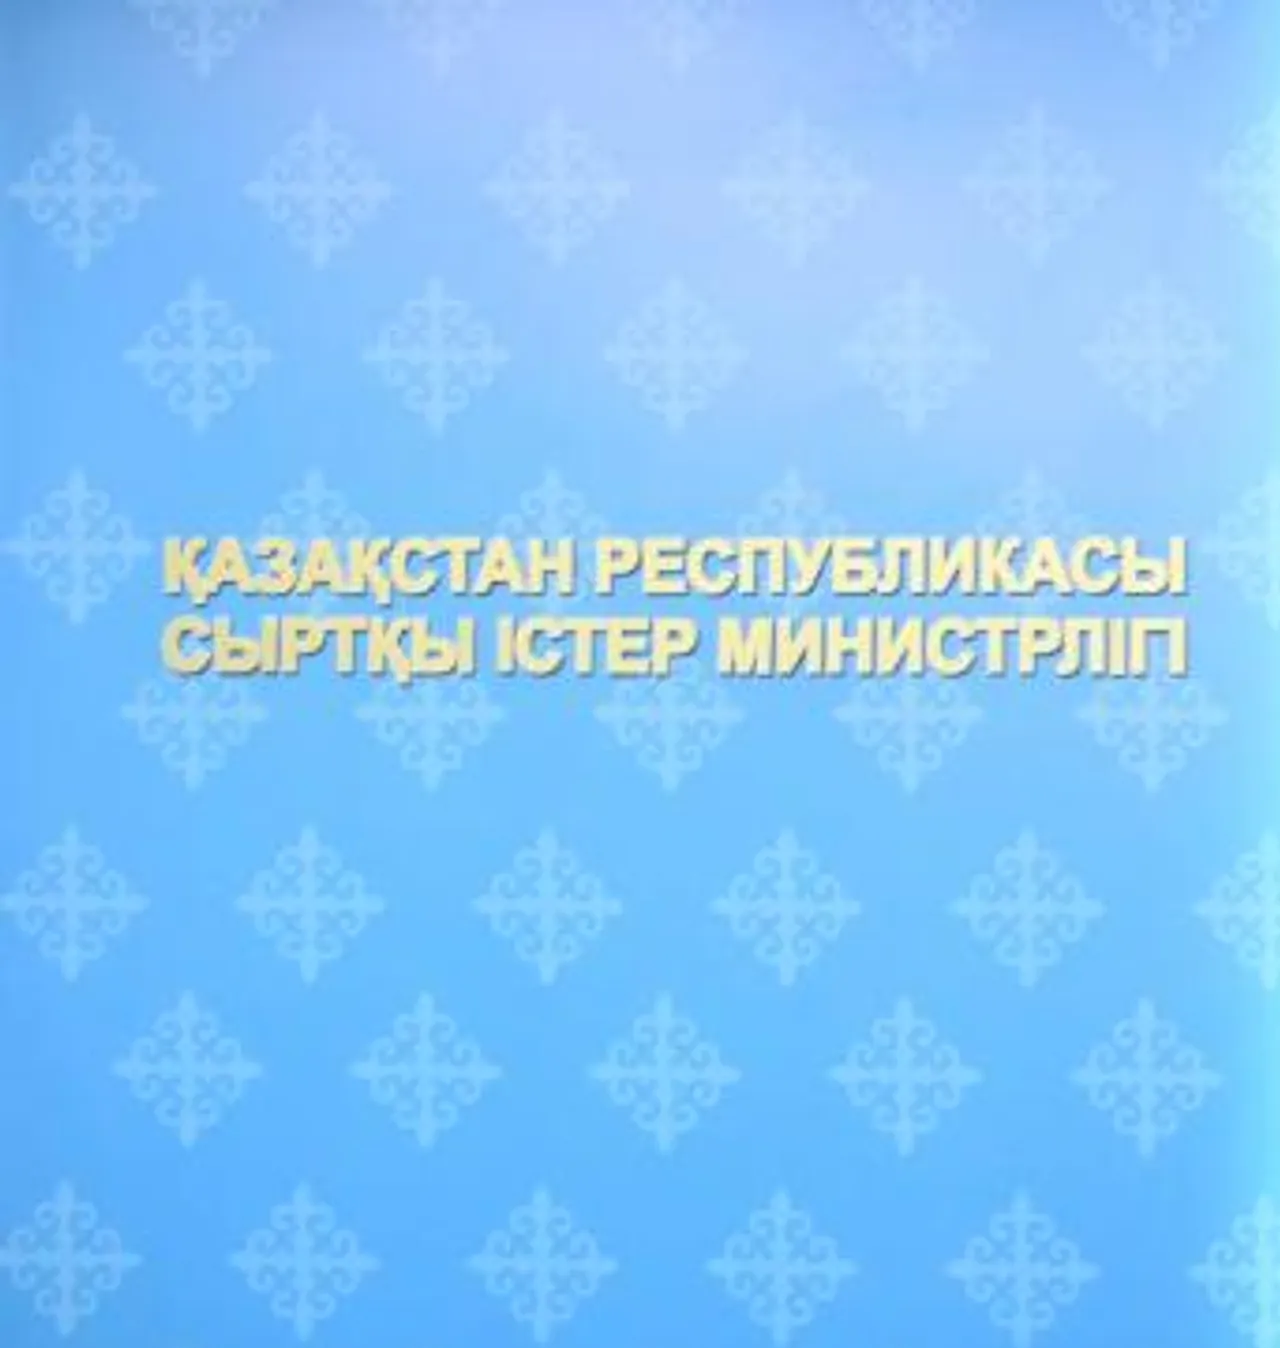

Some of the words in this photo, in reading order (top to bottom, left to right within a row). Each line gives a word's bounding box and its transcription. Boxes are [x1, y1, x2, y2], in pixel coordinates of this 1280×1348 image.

[162, 536, 576, 604] ҚАЗАҚСТАН
[595, 535, 1188, 597] РЕСПУБЛИКАСЫ
[161, 615, 477, 684] СЫРТҚЫ
[496, 615, 698, 678] ІСТЕР
